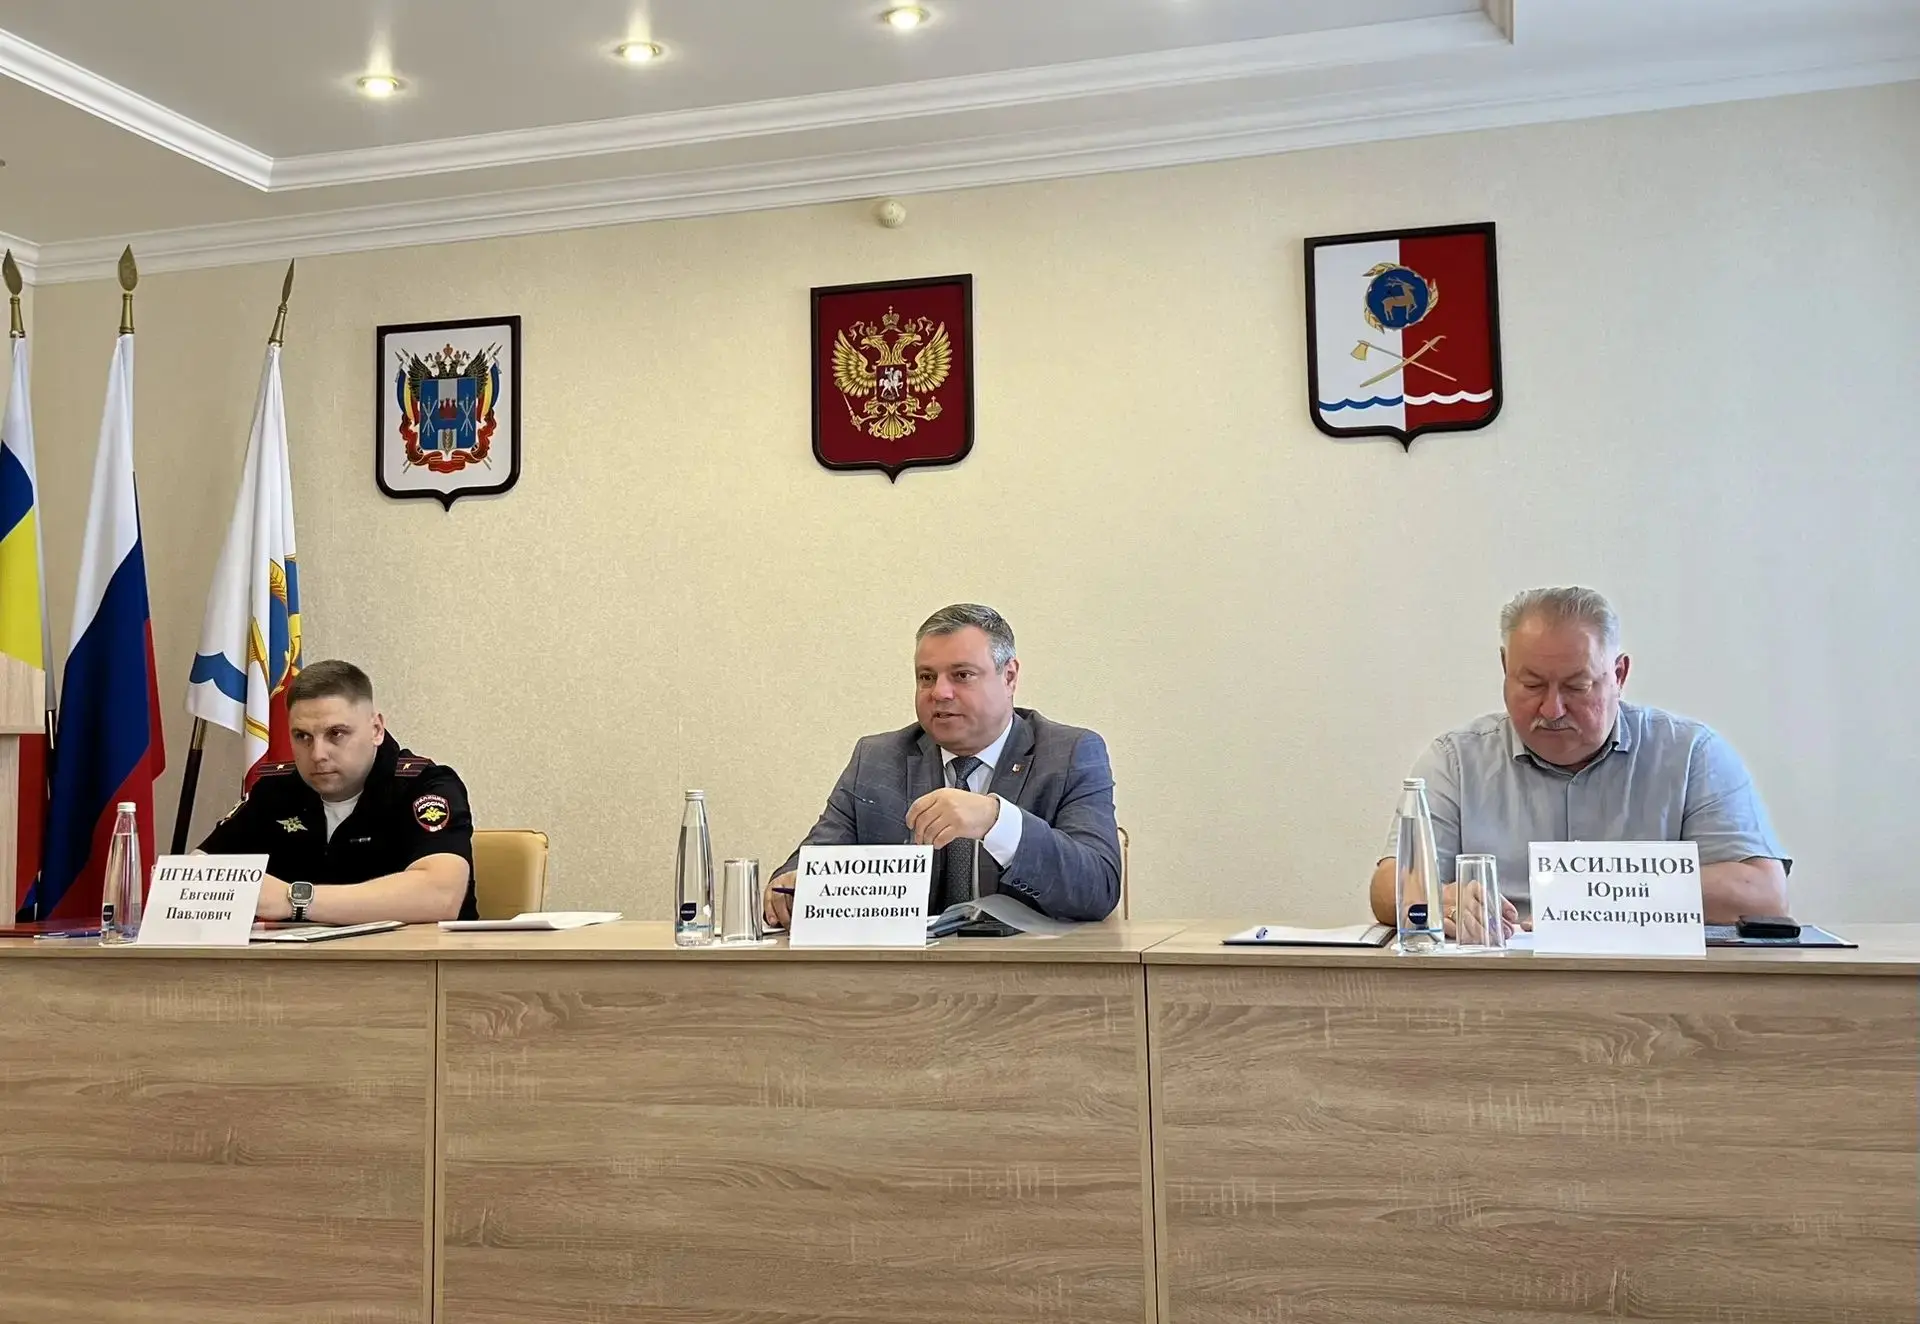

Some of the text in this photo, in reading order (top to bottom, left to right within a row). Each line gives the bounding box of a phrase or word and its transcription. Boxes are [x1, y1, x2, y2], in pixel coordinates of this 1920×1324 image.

[805, 854, 927, 877] КАМОЦКИЙ
[1537, 856, 1695, 876] ВАСИЛЬЦОВ
[160, 867, 263, 883] ИГНАТЕНКО
[179, 887, 235, 901] Евгений
[819, 883, 907, 899] Александр
[1587, 881, 1650, 901] Юрий
[166, 906, 232, 920] Павлович
[804, 904, 920, 919] Вячеславович
[1541, 906, 1702, 927] Александрович
